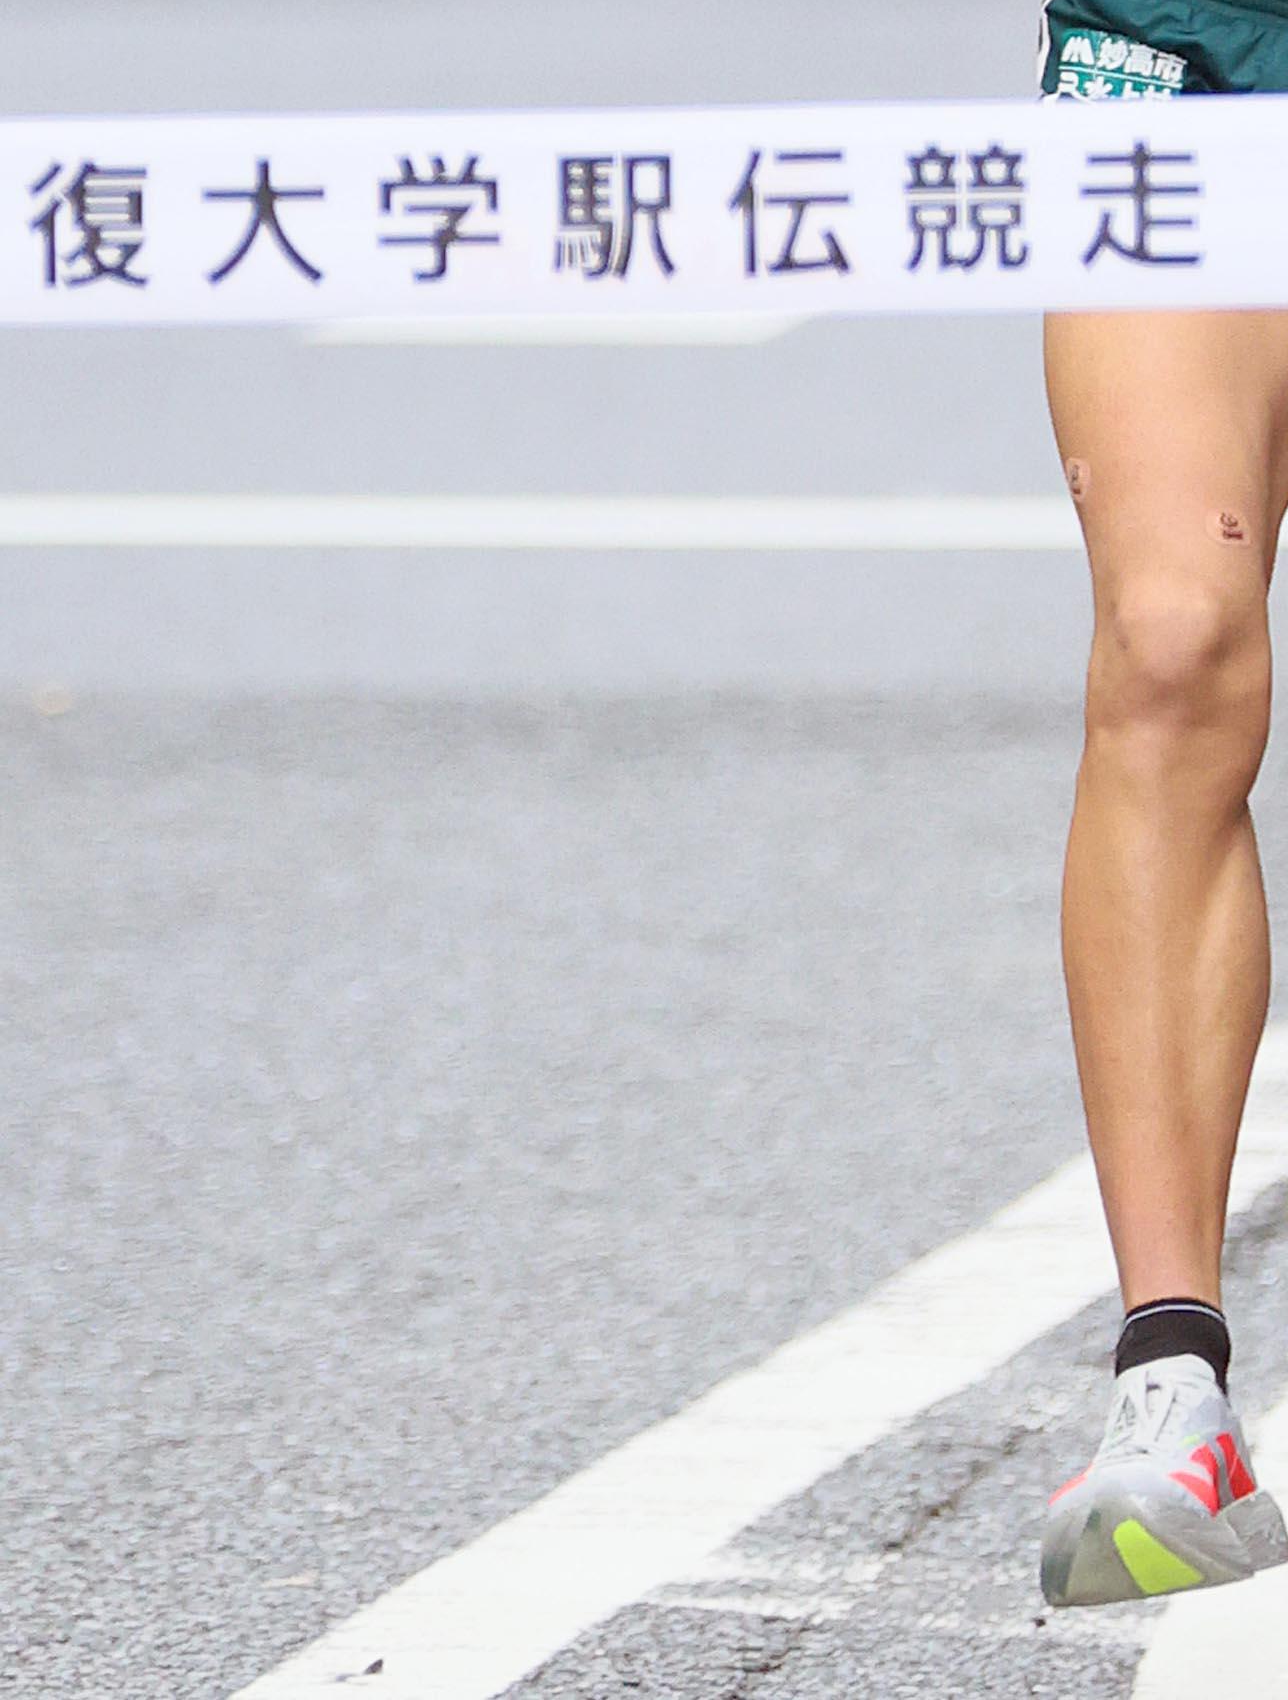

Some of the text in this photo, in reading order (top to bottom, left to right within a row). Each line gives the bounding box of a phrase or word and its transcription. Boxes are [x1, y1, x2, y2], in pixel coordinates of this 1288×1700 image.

[28, 141, 1203, 289] 復大学駅伝競走
